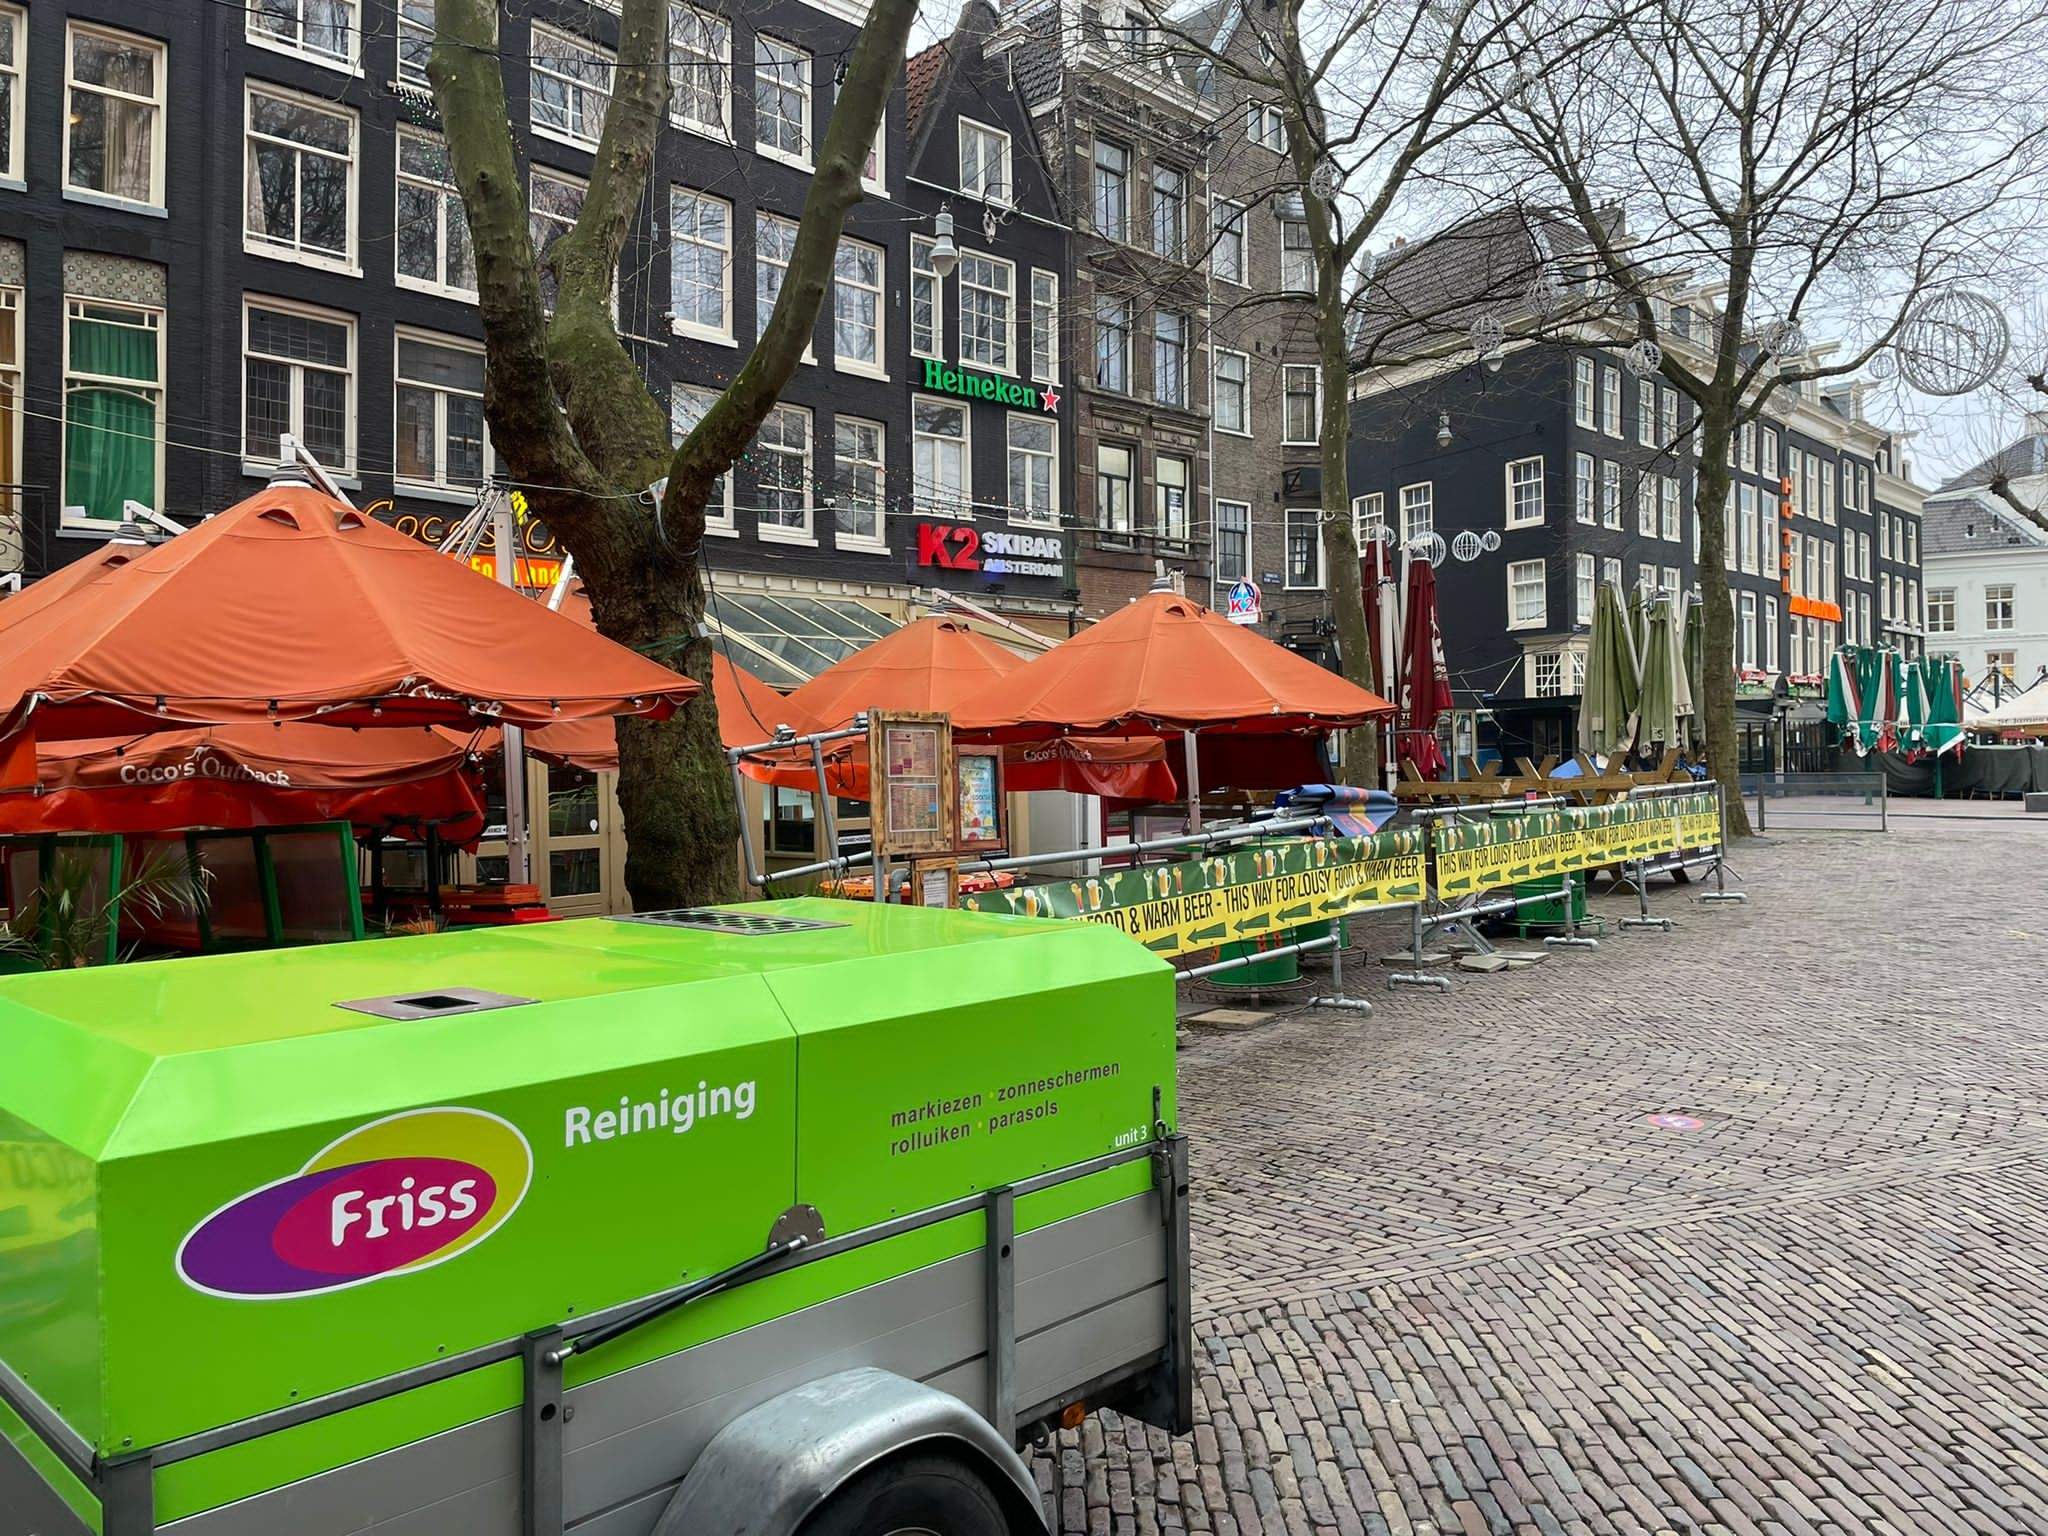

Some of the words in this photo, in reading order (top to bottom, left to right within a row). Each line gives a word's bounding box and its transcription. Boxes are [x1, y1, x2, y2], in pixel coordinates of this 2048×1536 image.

[923, 360, 1037, 408] Heineken
[917, 523, 980, 571] K2
[982, 531, 1063, 560] SKIBAR
[983, 558, 1064, 577] AMSTERDAM
[120, 762, 196, 784] Coco's
[1439, 854, 1456, 876] THIS
[1457, 851, 1473, 872] WAY
[1475, 848, 1489, 868] FOR
[1490, 845, 1511, 866] LOUSY
[1513, 841, 1530, 861] FOOD
[1532, 840, 1538, 856] &
[1538, 836, 1559, 856] WARM
[1560, 833, 1577, 852] BEER
[1086, 910, 1126, 933] OD
[1129, 907, 1141, 934] &
[1142, 899, 1181, 931] WARM
[1183, 892, 1214, 923] BEER
[1223, 886, 1249, 913] THIS
[1251, 881, 1276, 905] WAY
[1275, 876, 1297, 903] FOR
[1298, 870, 1332, 897] LOUSY
[1334, 864, 1355, 889] FOOD
[1356, 863, 1364, 885] &
[1364, 858, 1392, 883] WARM
[1394, 856, 1420, 878] BEER
[565, 1080, 756, 1148] Reiniging
[891, 1092, 983, 1128] markiezen
[997, 1061, 1121, 1103] zonneschermen
[891, 1122, 971, 1156] rolluiken
[988, 1099, 1059, 1135] parasols
[1115, 1128, 1138, 1147] unit
[1139, 1124, 1148, 1140] 3
[331, 1176, 478, 1247] Friss
